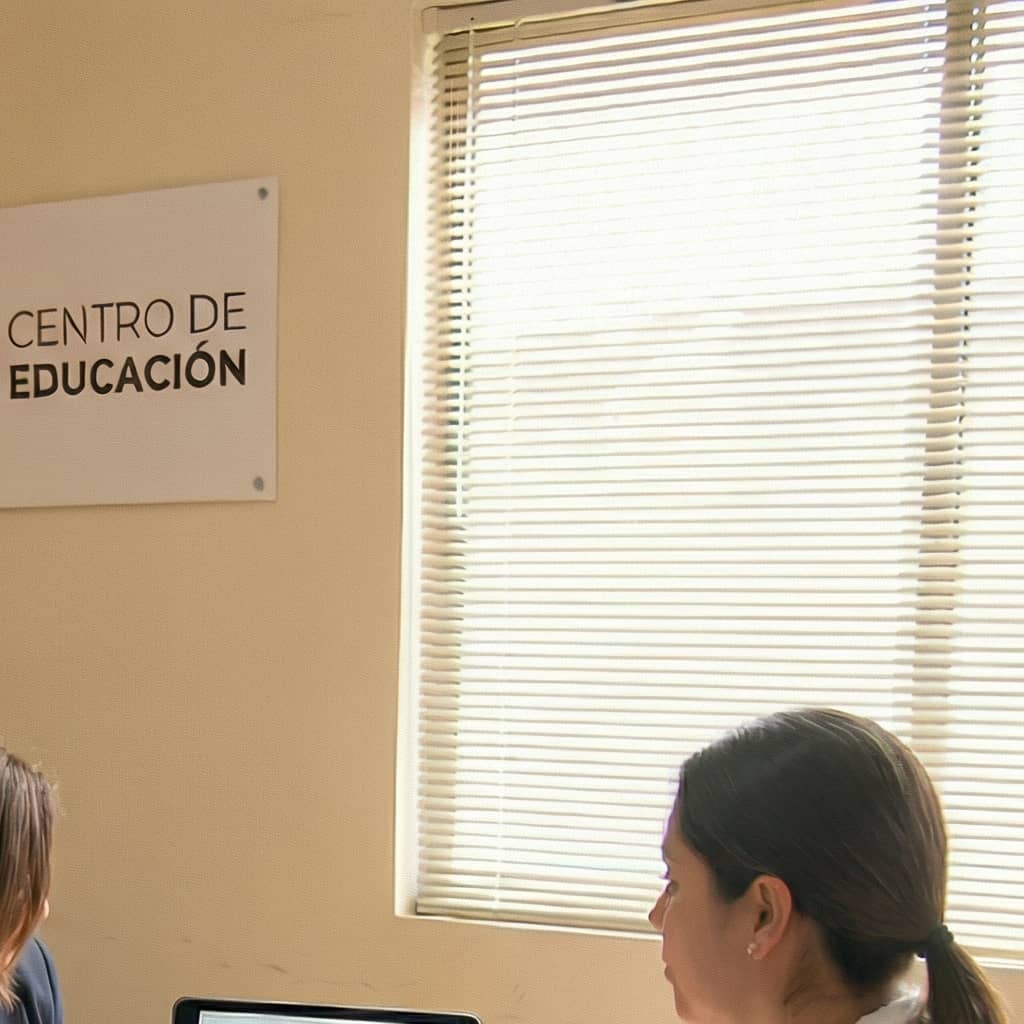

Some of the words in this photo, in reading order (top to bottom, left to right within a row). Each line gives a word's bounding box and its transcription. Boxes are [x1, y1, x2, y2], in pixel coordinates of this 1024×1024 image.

[8, 298, 174, 348] CENTRO
[189, 291, 247, 334] DE
[9, 340, 246, 400] EDUCACIÓN
